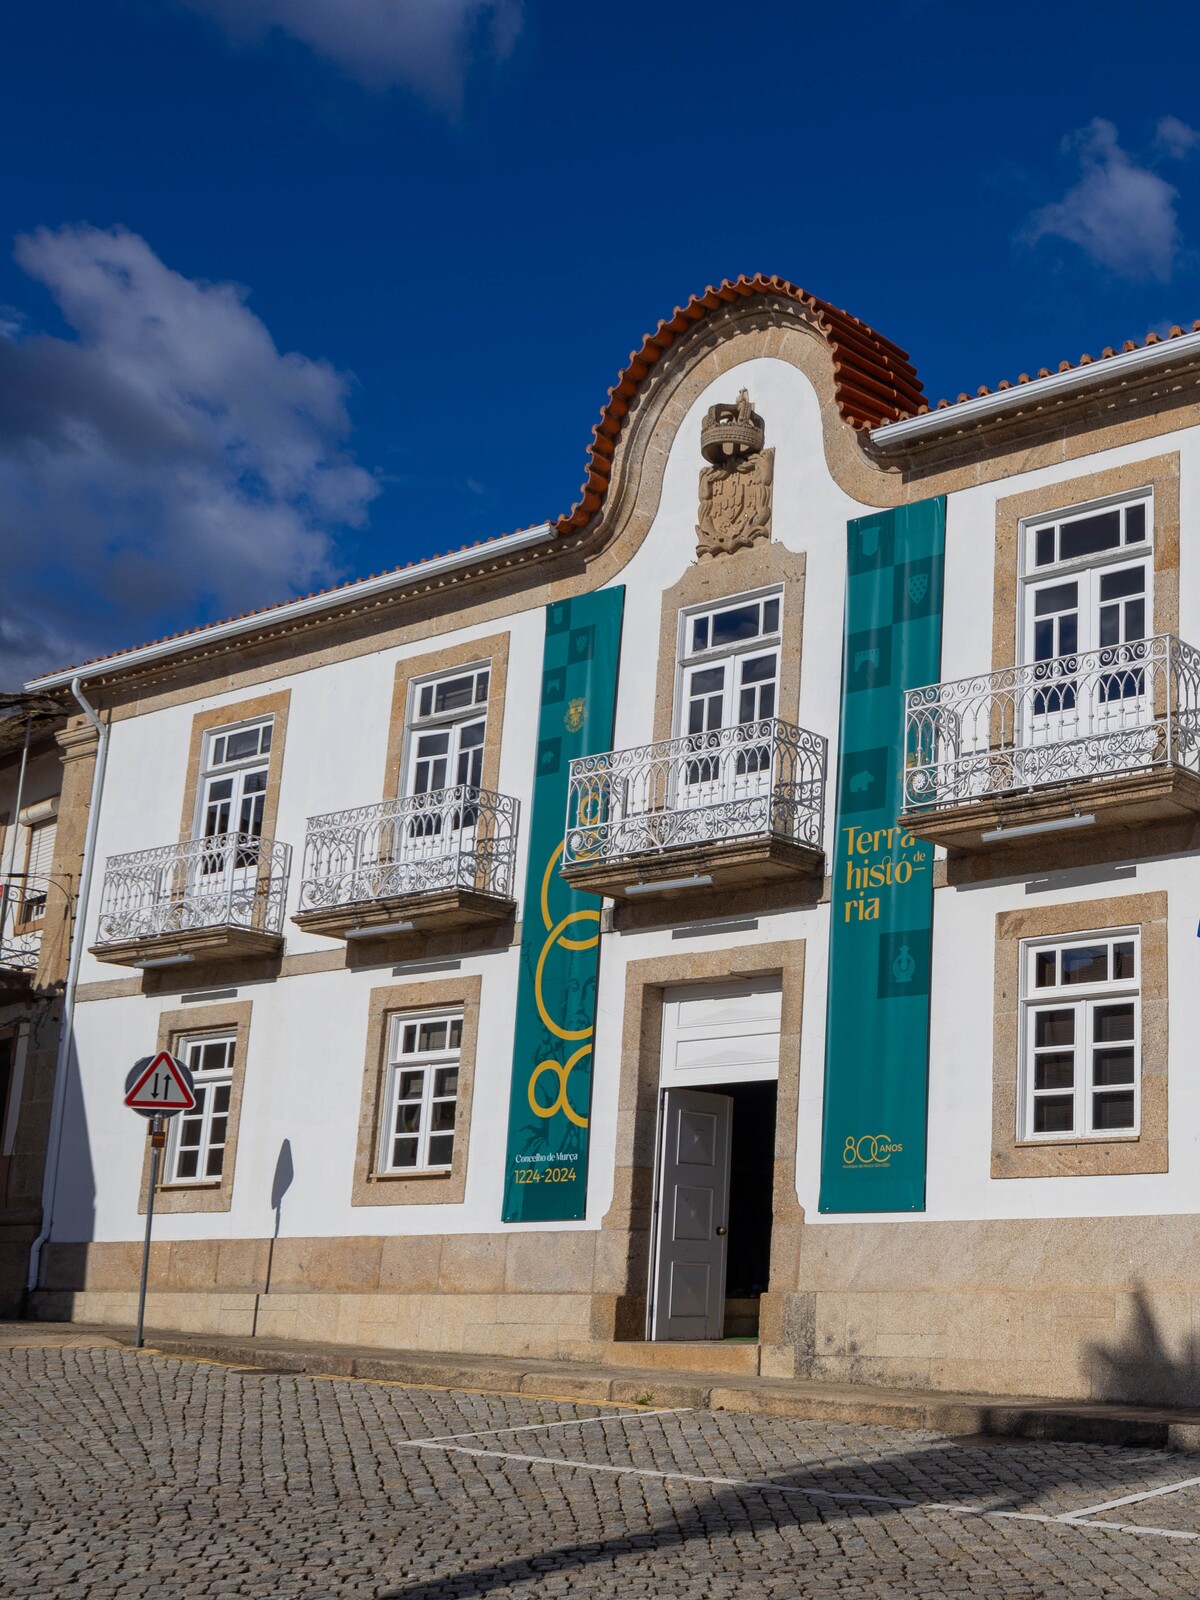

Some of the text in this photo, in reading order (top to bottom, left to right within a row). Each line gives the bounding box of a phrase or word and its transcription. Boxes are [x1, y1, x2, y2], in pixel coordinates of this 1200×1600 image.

[842, 825, 916, 855] Terra
[913, 851, 926, 862] de
[844, 891, 880, 923] ria
[880, 1143, 903, 1152] ANOS
[515, 1152, 578, 1163] Concelho de Murça
[514, 1167, 577, 1184] 1224-2024
